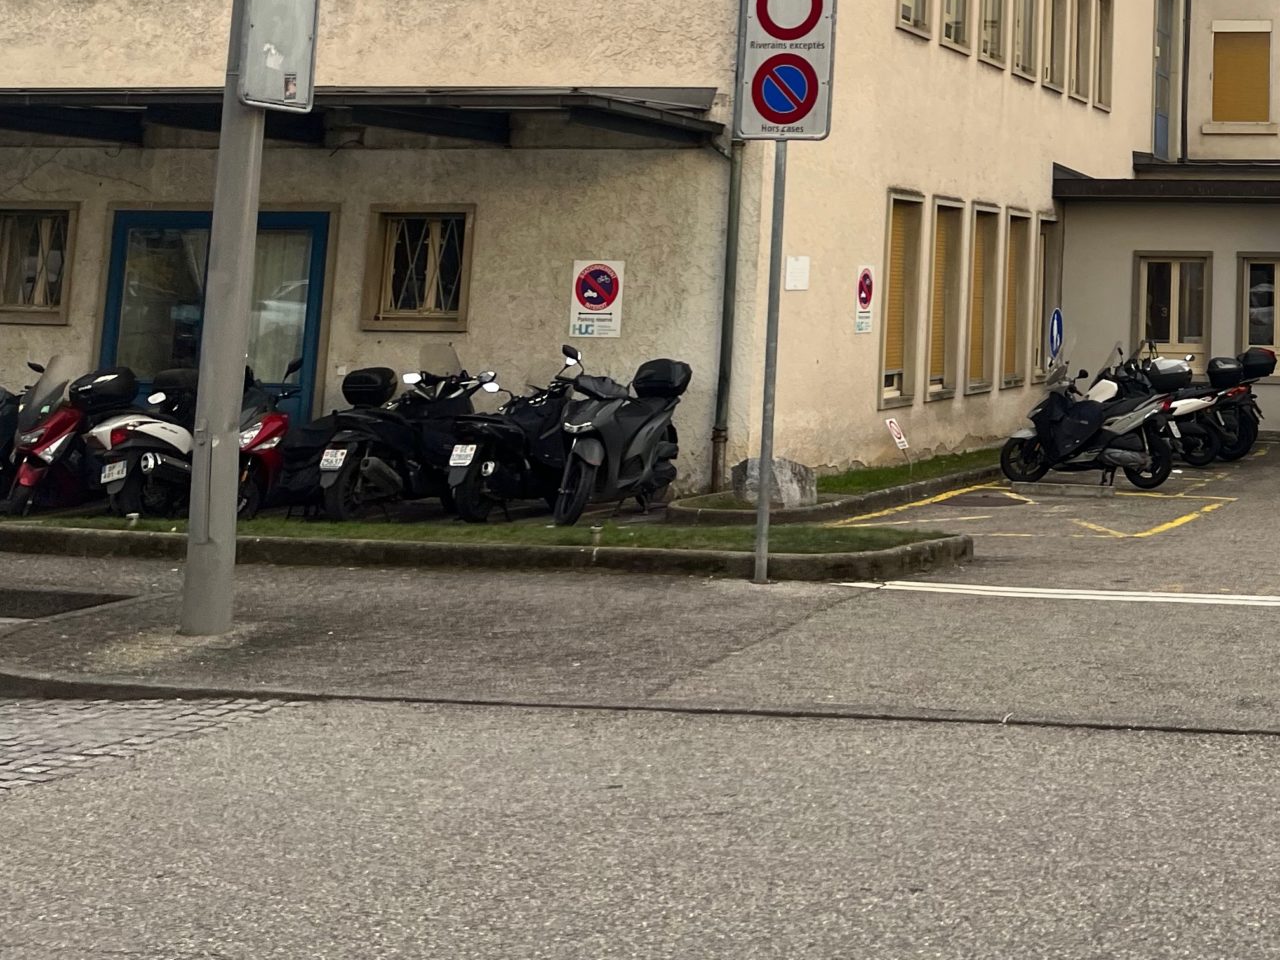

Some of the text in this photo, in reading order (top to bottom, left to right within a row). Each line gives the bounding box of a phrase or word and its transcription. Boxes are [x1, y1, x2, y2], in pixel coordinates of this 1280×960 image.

[750, 41, 825, 50] Riverains exceptés
[761, 124, 780, 133] Hors
[572, 324, 594, 335] HUG
